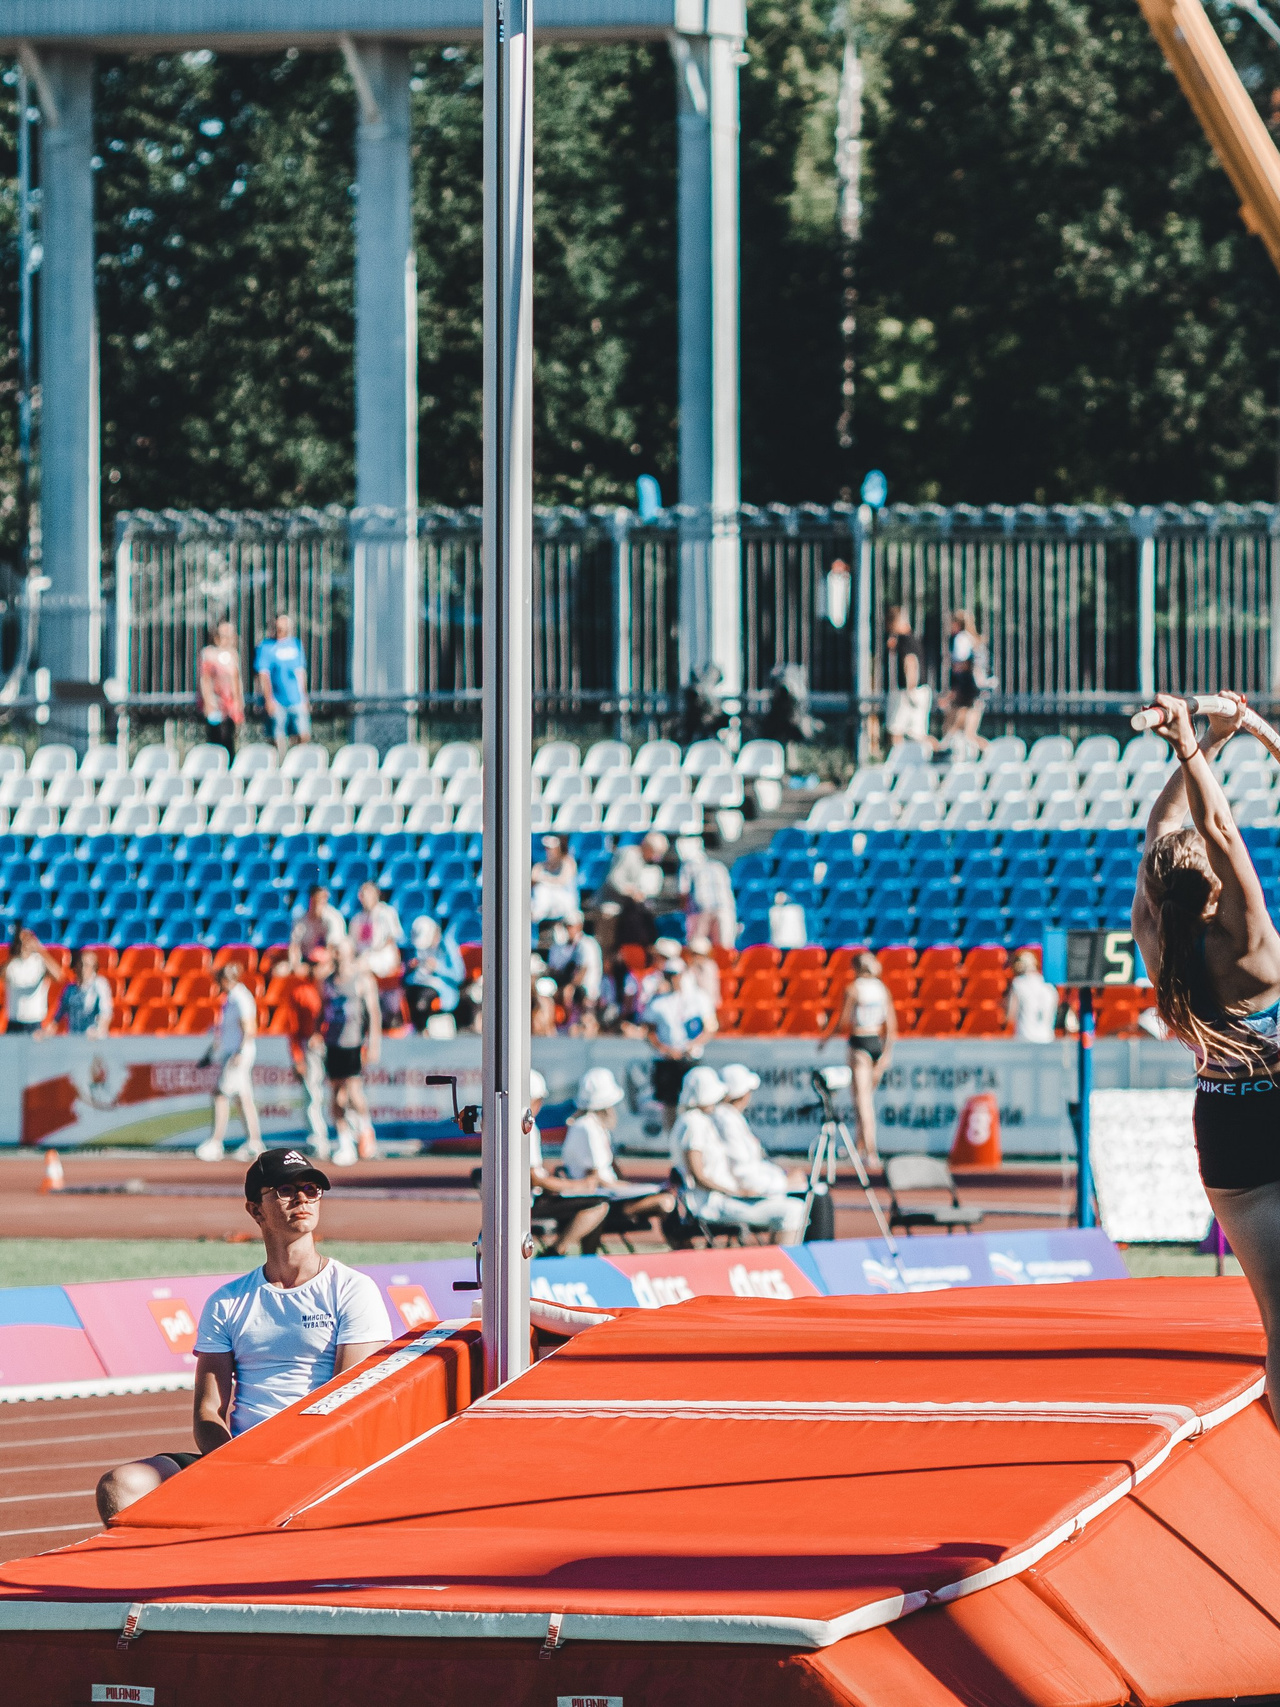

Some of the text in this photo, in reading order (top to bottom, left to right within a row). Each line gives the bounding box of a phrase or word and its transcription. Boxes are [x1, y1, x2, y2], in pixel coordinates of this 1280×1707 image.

[1103, 932, 1133, 983] 5
[1198, 1079, 1237, 1096] NIKE
[105, 1686, 141, 1702] POLANIK
